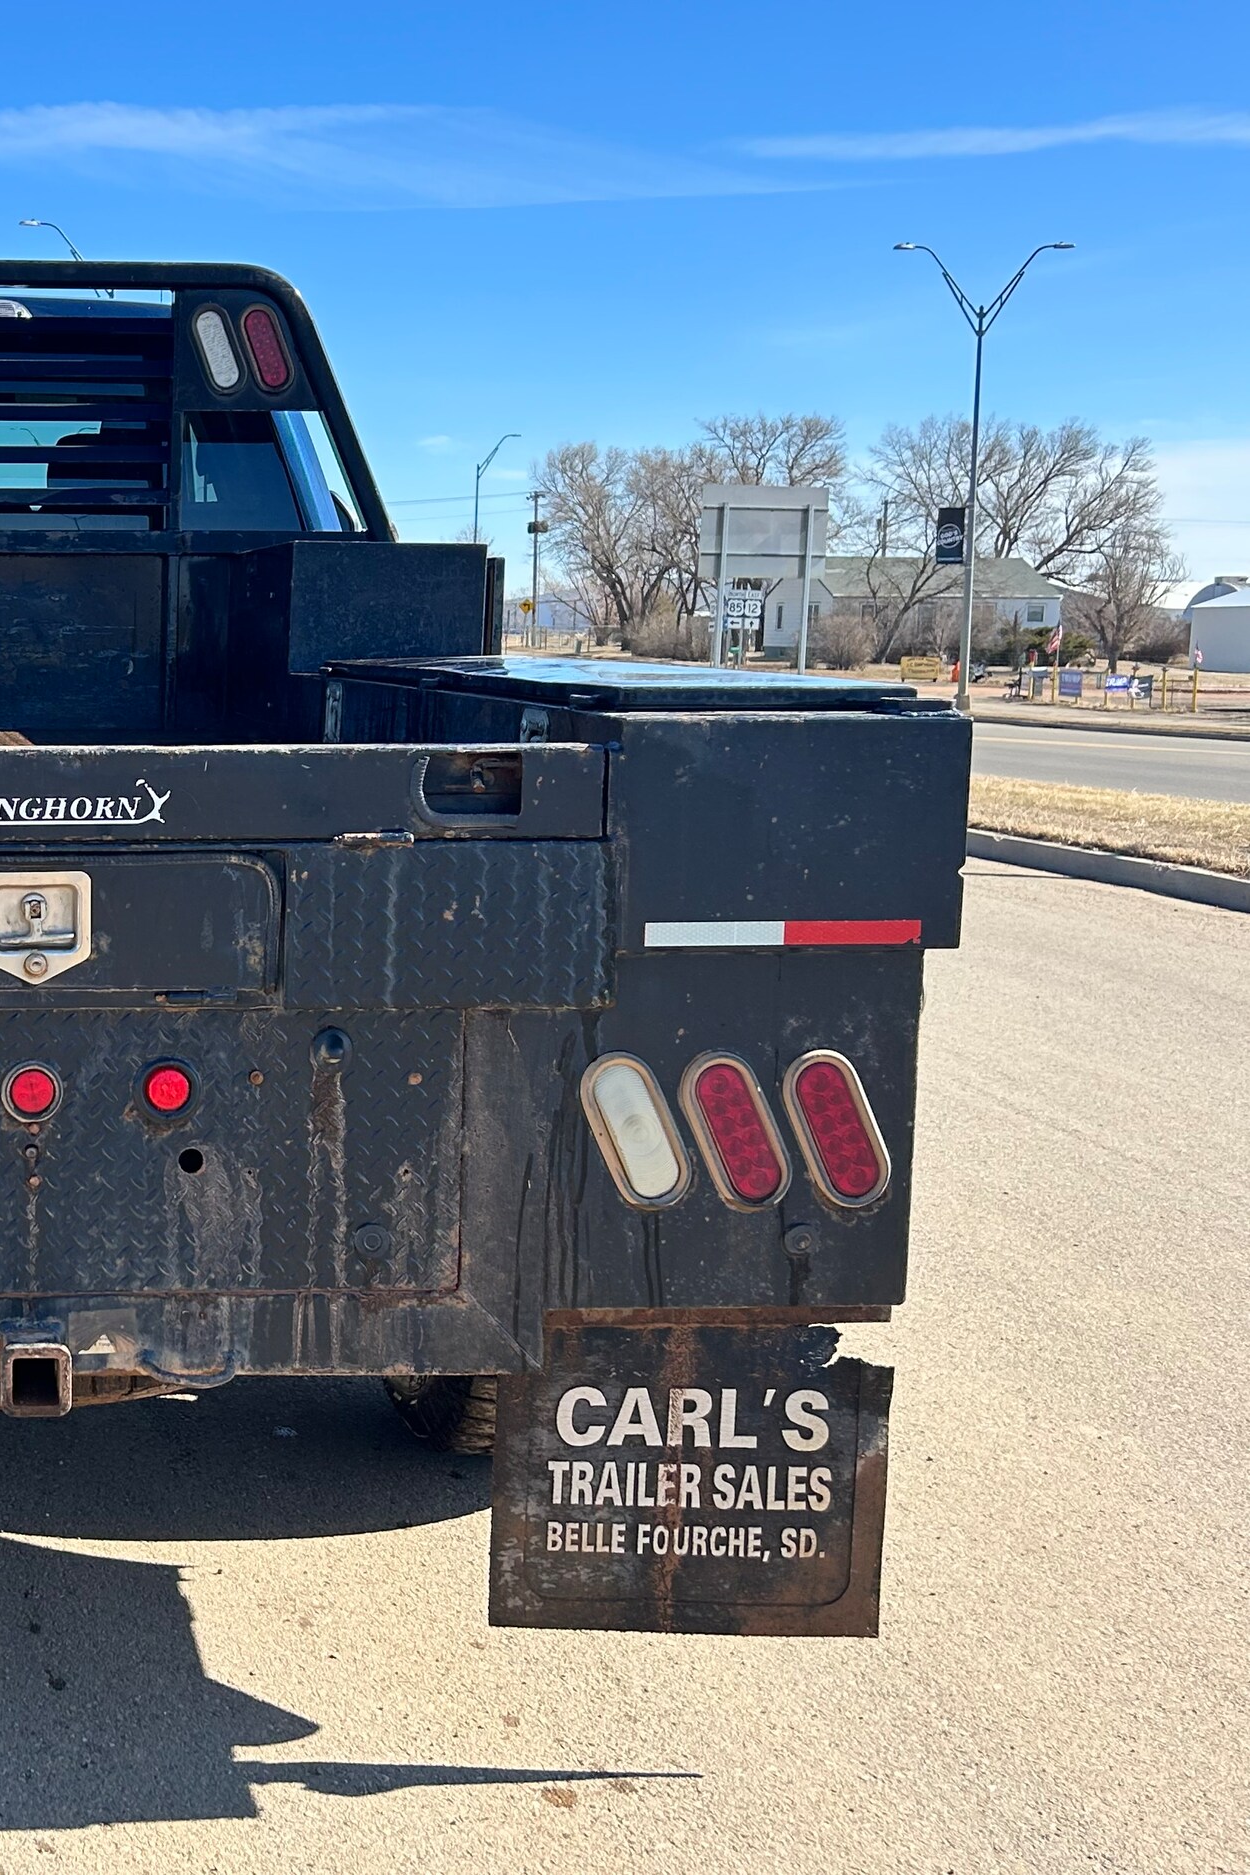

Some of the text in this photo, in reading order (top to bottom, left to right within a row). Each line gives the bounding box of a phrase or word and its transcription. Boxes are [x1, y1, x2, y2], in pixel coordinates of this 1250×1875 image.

[729, 602, 743, 613] 85
[748, 603, 758, 614] 12
[555, 1385, 830, 1452] CARL'S
[547, 1460, 833, 1512] TRAILER SALES
[546, 1520, 826, 1562] BELLE FOURCHE, SD.
